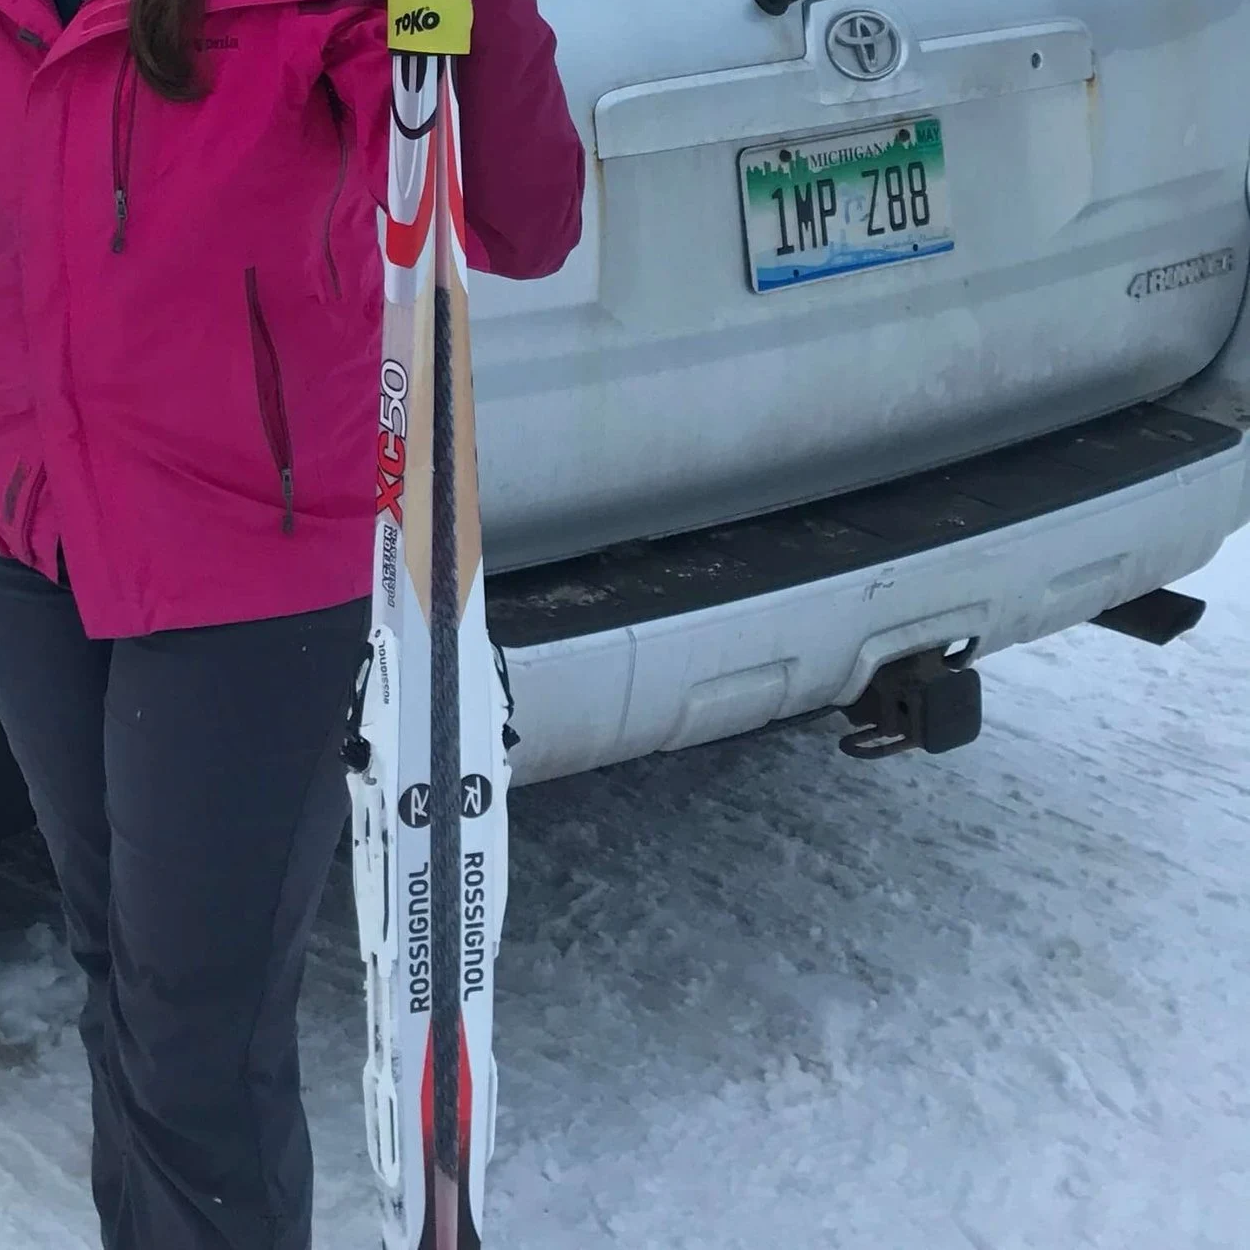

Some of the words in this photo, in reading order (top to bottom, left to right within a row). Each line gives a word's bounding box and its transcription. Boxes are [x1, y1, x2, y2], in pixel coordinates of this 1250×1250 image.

[395, 7, 440, 36] TOKO
[810, 142, 884, 168] MICHIGAN
[918, 126, 939, 142] MAY
[771, 178, 837, 256] 1MP
[861, 161, 930, 236] Z88
[375, 358, 410, 527] XC50
[378, 640, 390, 705] ROSSIGNOL
[409, 861, 431, 1014] ROSSIGNOL
[463, 852, 485, 1002] ROSSIGNOL
